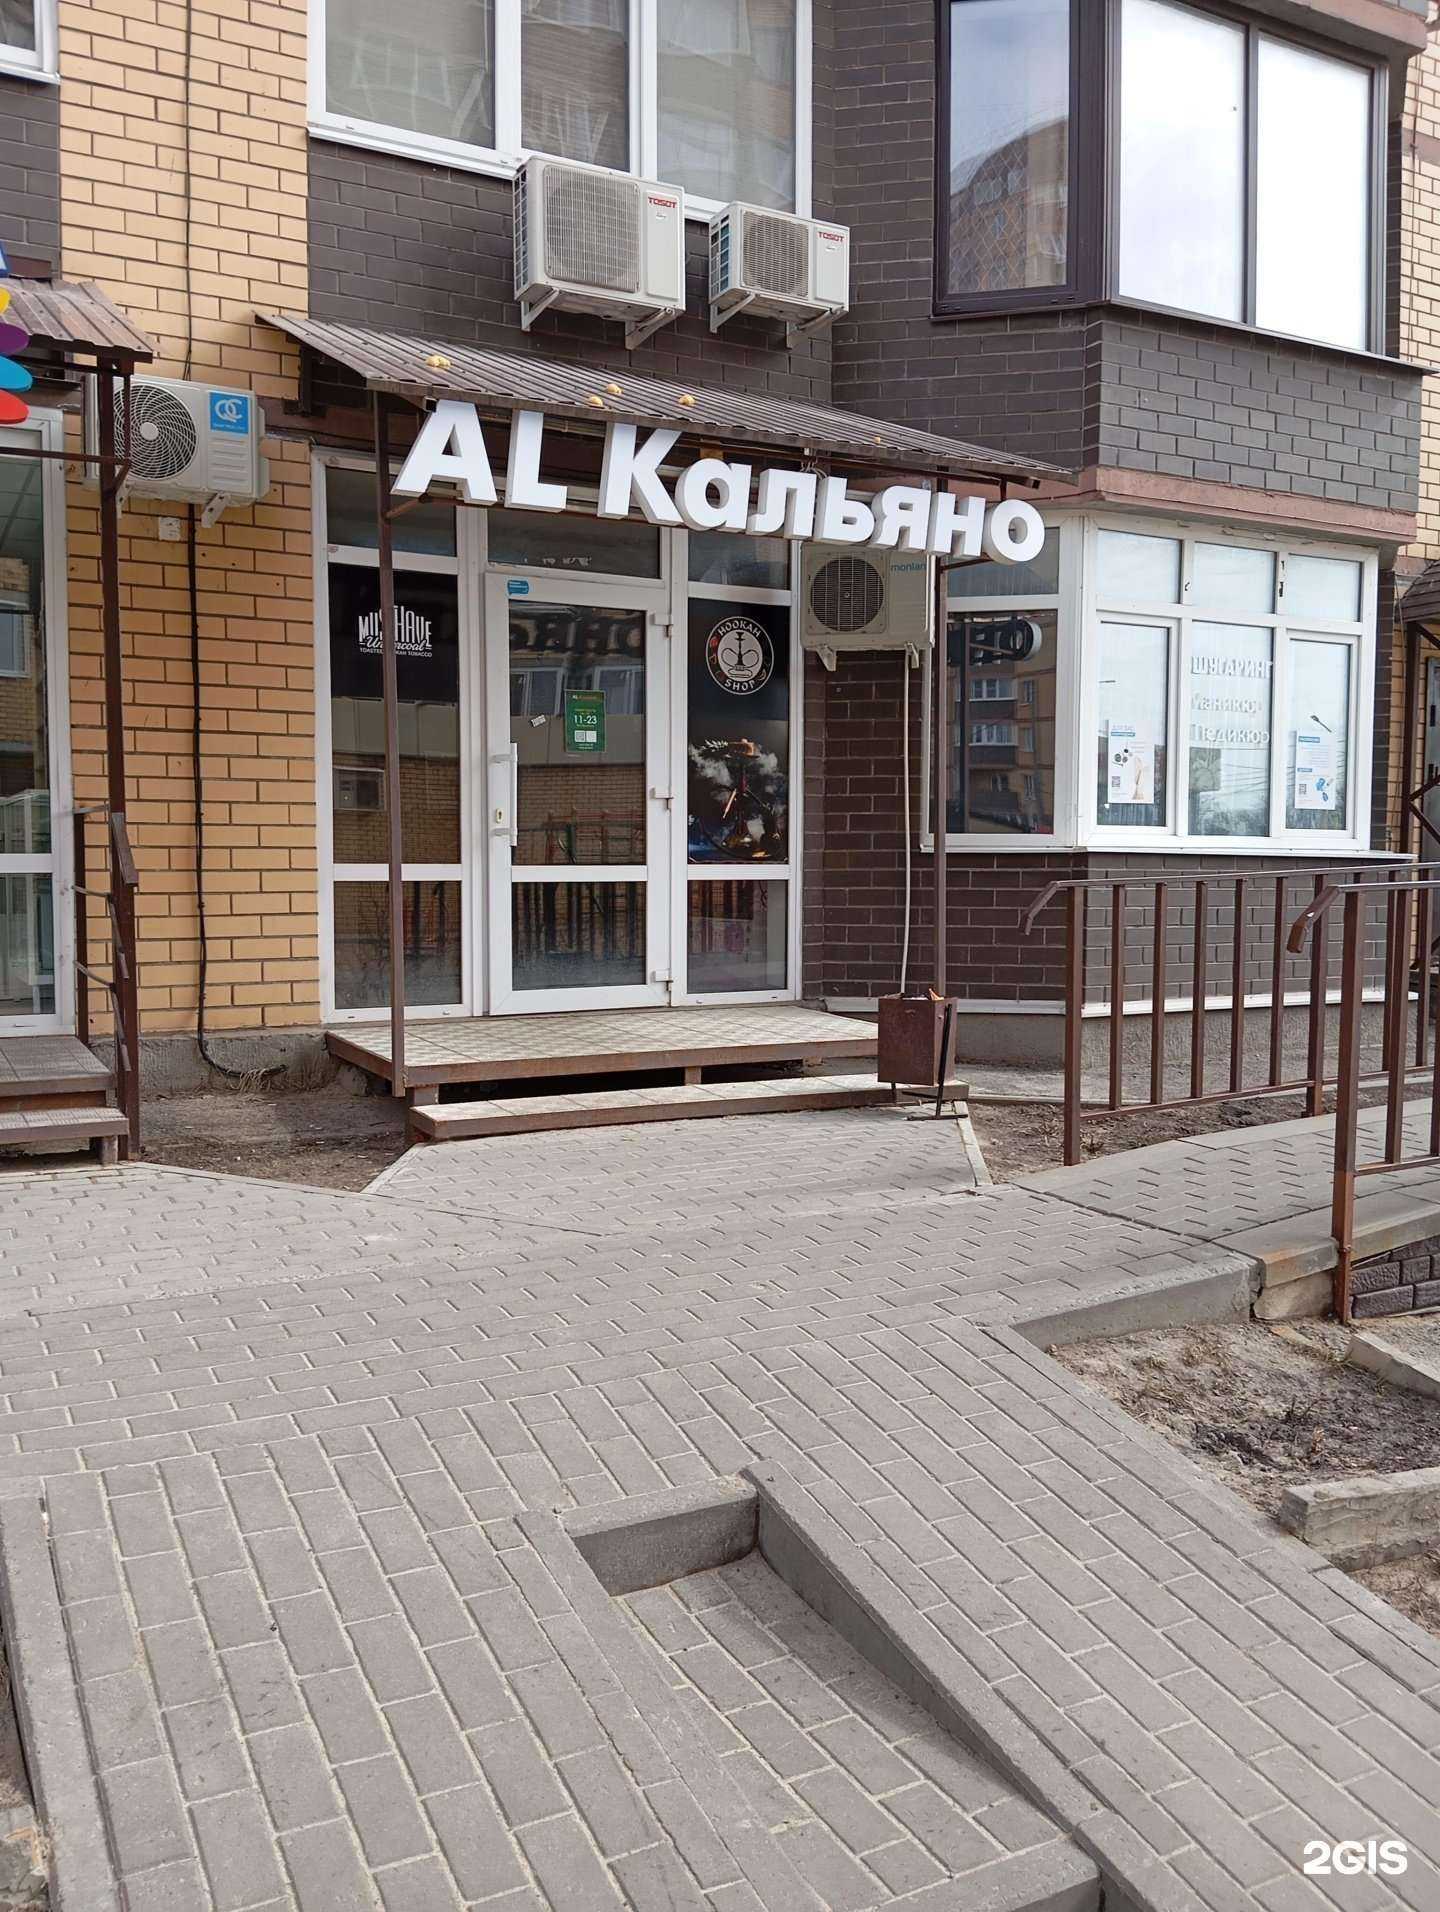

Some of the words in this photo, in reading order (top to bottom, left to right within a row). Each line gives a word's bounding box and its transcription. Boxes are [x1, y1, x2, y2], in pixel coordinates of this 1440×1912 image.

[647, 196, 678, 209] TOSOT
[818, 231, 845, 243] TOSOT
[717, 620, 762, 637] HOOKAH
[724, 679, 756, 692] SHOP
[574, 714, 598, 725] 11-23
